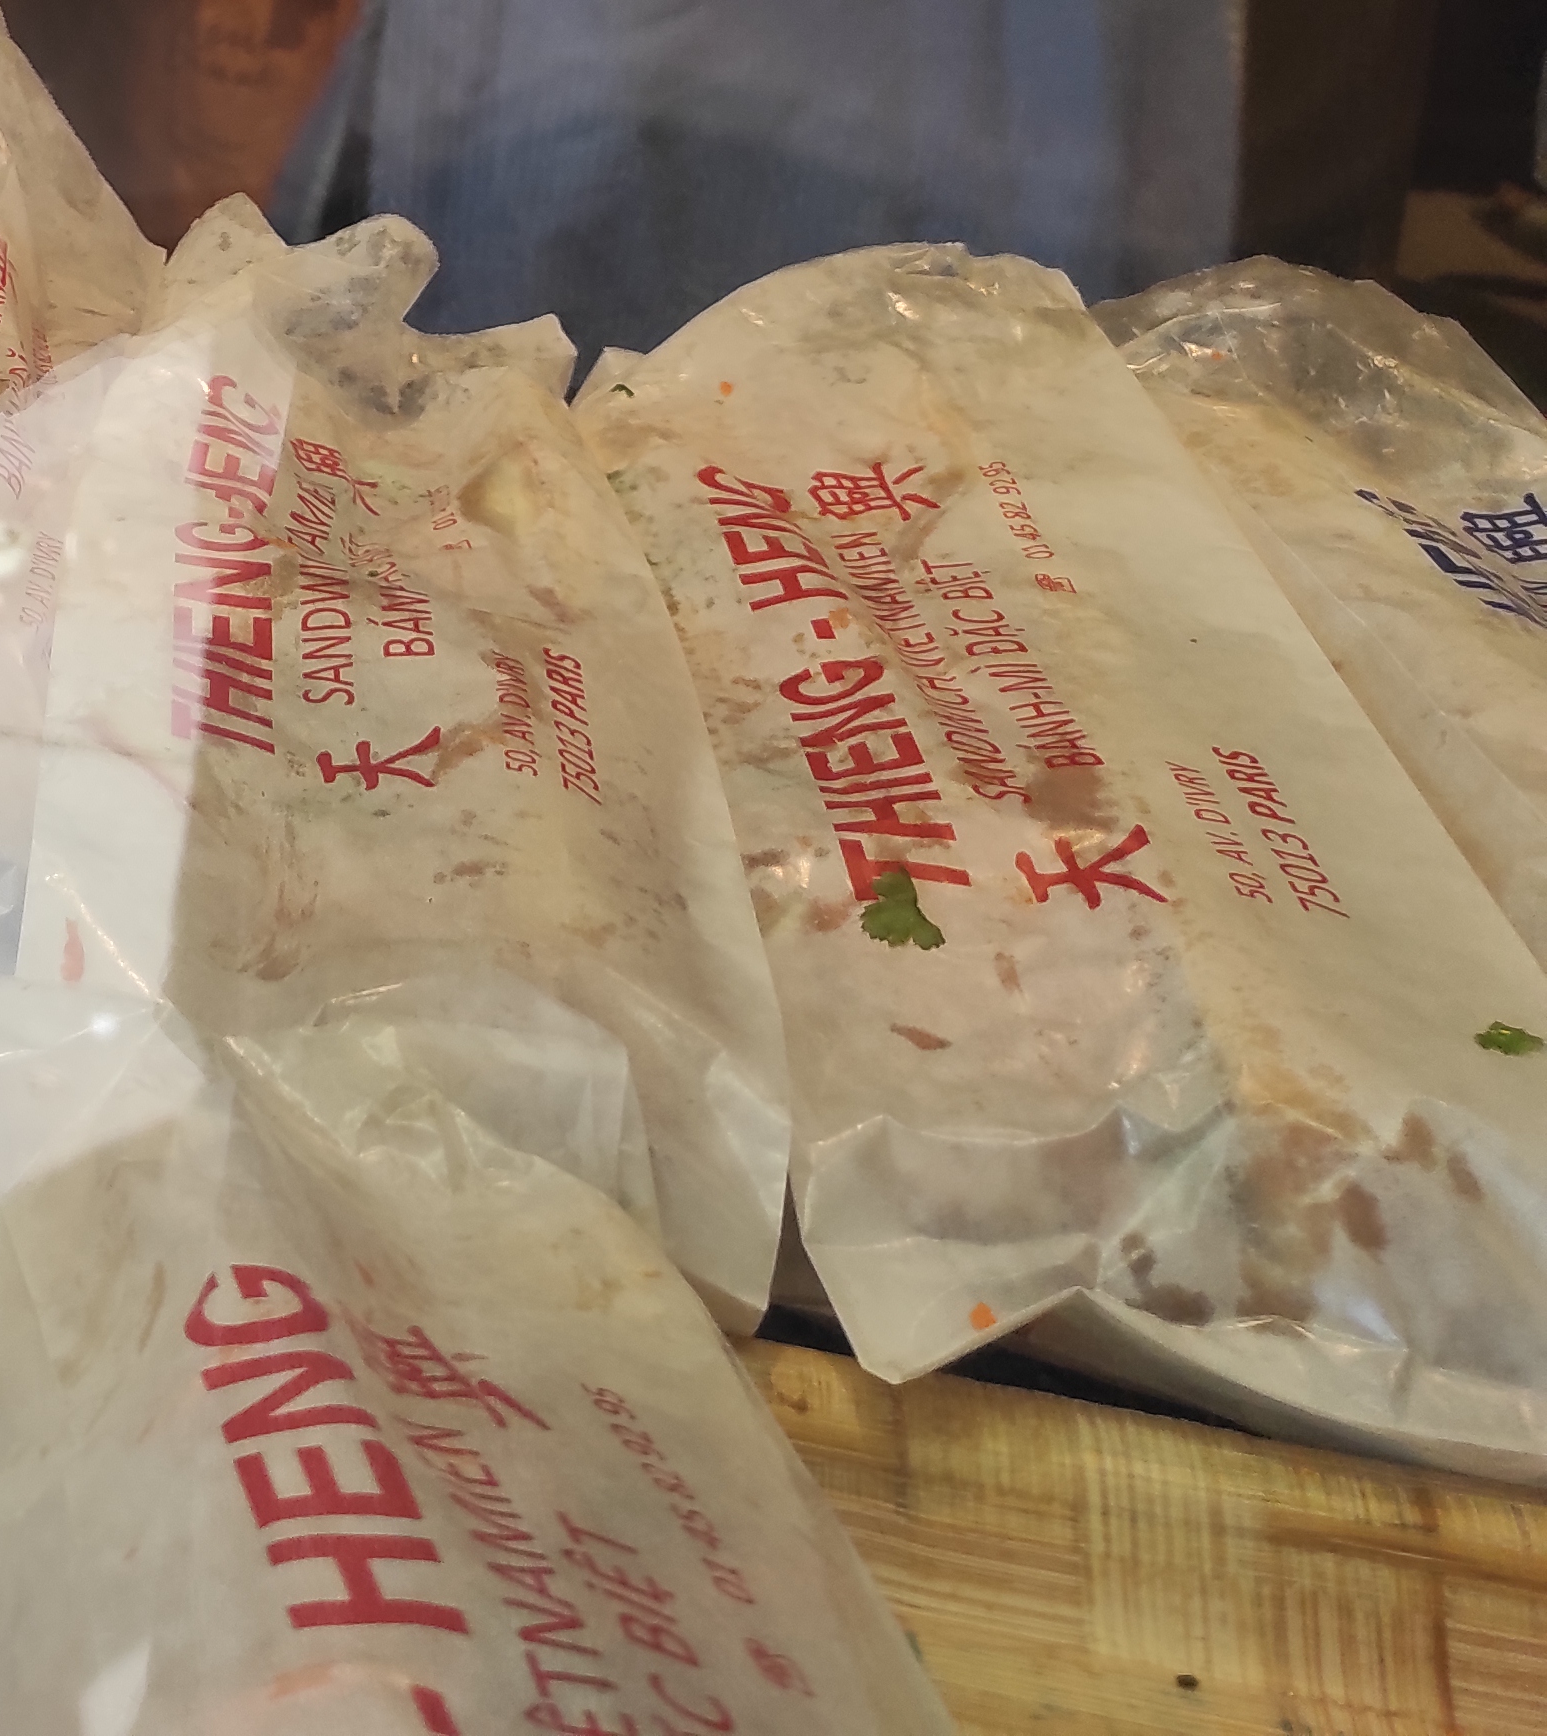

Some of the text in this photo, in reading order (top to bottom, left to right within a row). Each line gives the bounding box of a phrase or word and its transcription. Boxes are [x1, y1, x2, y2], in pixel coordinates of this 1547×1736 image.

[696, 464, 849, 613] HENG
[978, 460, 1055, 561] 01 45 82 92 95
[171, 521, 276, 755] THIENG
[500, 711, 536, 747] AV.
[503, 748, 543, 777] 50,
[542, 646, 603, 808] 75013 PARIS
[779, 654, 972, 903] THIENG
[914, 675, 1034, 804] SANDWICH
[1205, 830, 1255, 867] AV.
[1211, 744, 1351, 920] 75013 PARIS
[183, 1261, 473, 1637] HENG
